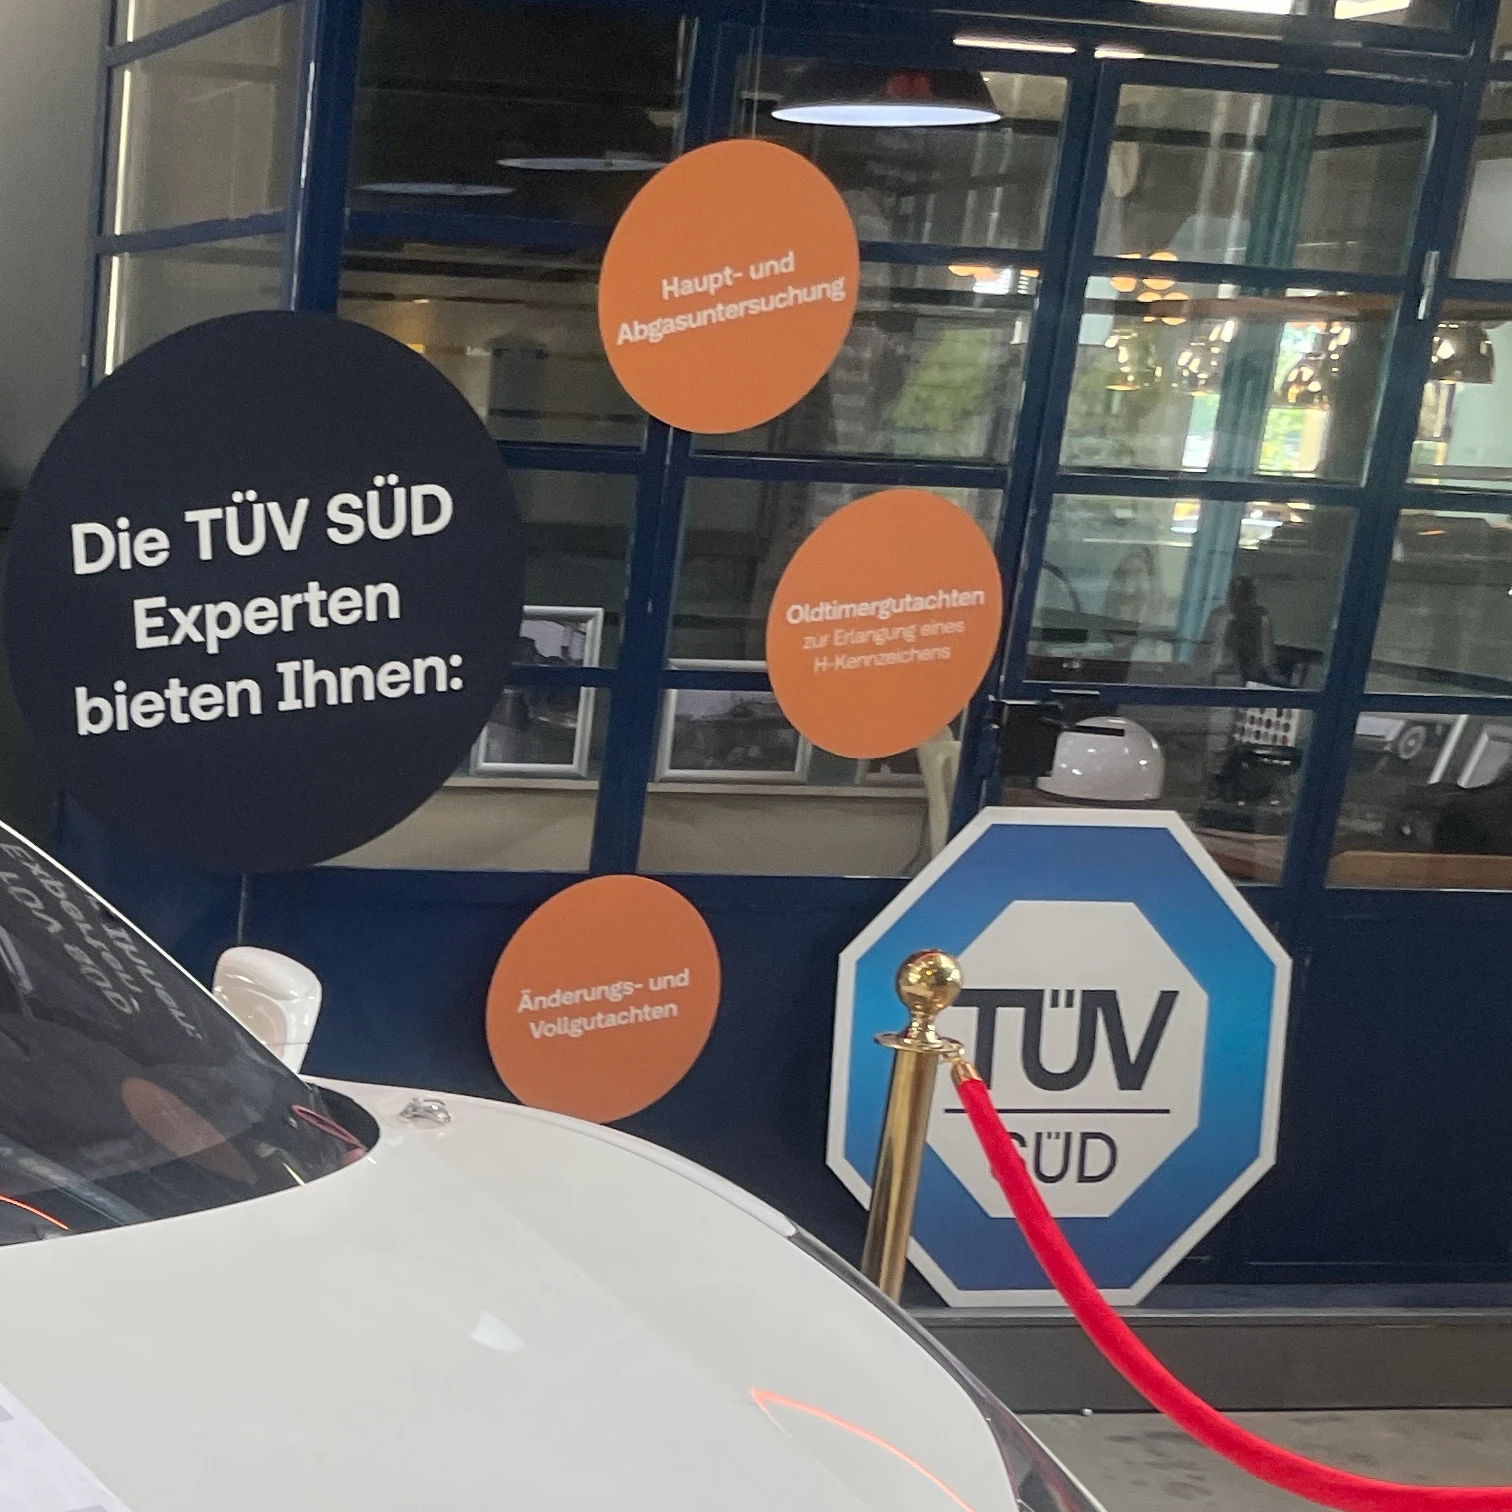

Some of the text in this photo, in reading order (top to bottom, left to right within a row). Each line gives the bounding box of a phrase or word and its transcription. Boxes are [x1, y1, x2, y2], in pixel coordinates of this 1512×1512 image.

[662, 250, 795, 299] Haupt- und
[616, 276, 846, 345] Abgasuntersuchung
[71, 473, 454, 575] Die TÜV SÜD
[133, 581, 400, 654] Experten
[786, 589, 985, 624] Oldtimergutachten
[803, 620, 965, 650] zur Erlangung eines
[813, 646, 951, 674] H-Kennzeichens
[74, 654, 463, 736] bieten Ihnen:
[518, 968, 690, 1013] Änderungs- und
[529, 1003, 678, 1039] Vollgutachten
[951, 988, 1180, 1091] TÜV
[990, 1131, 1117, 1184] ÜD
